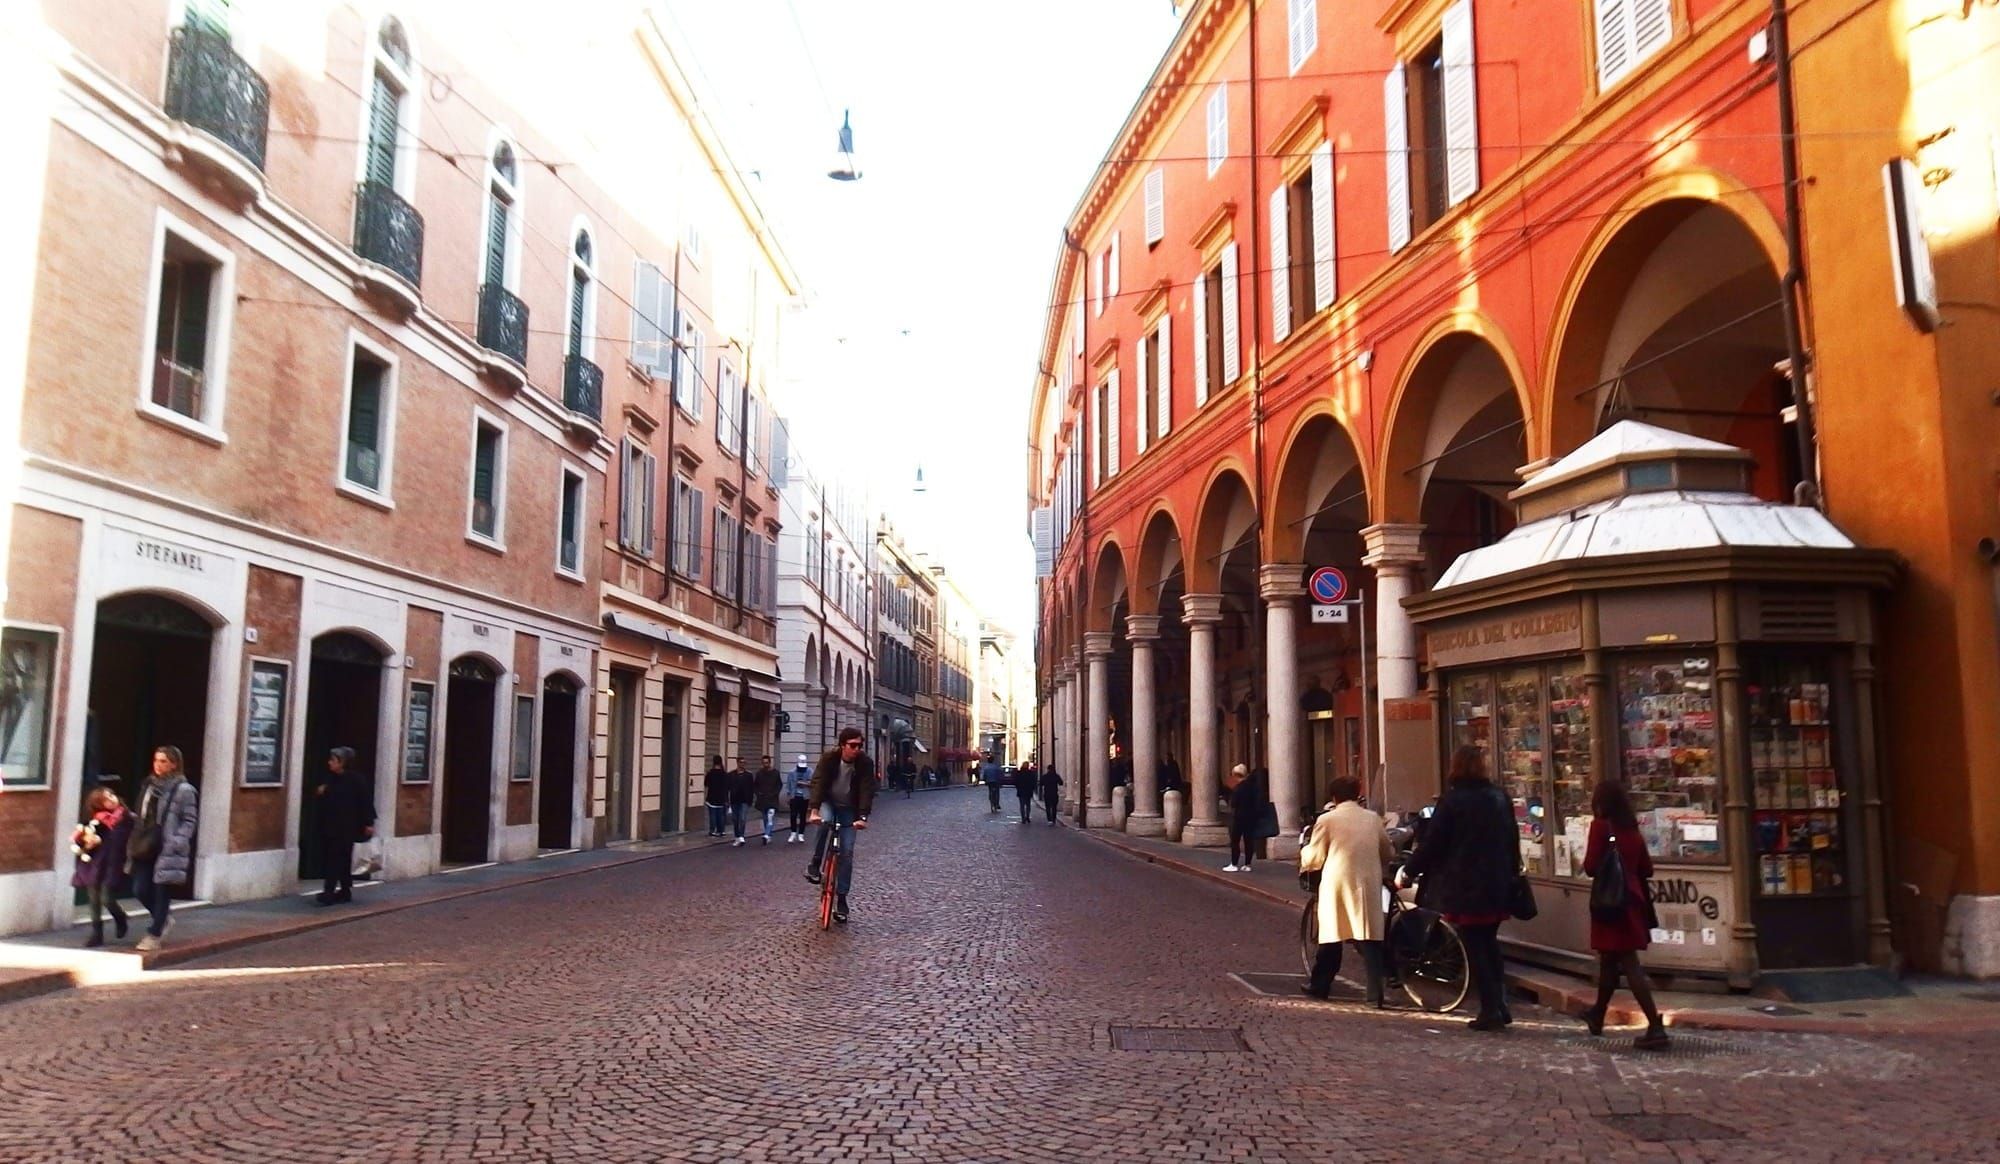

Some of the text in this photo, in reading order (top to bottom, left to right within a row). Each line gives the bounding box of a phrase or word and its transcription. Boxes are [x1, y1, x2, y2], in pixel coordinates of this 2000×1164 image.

[136, 541, 203, 571] STEFANEL
[1484, 623, 1506, 645] DEL
[1511, 610, 1579, 640] COLLEGIO
